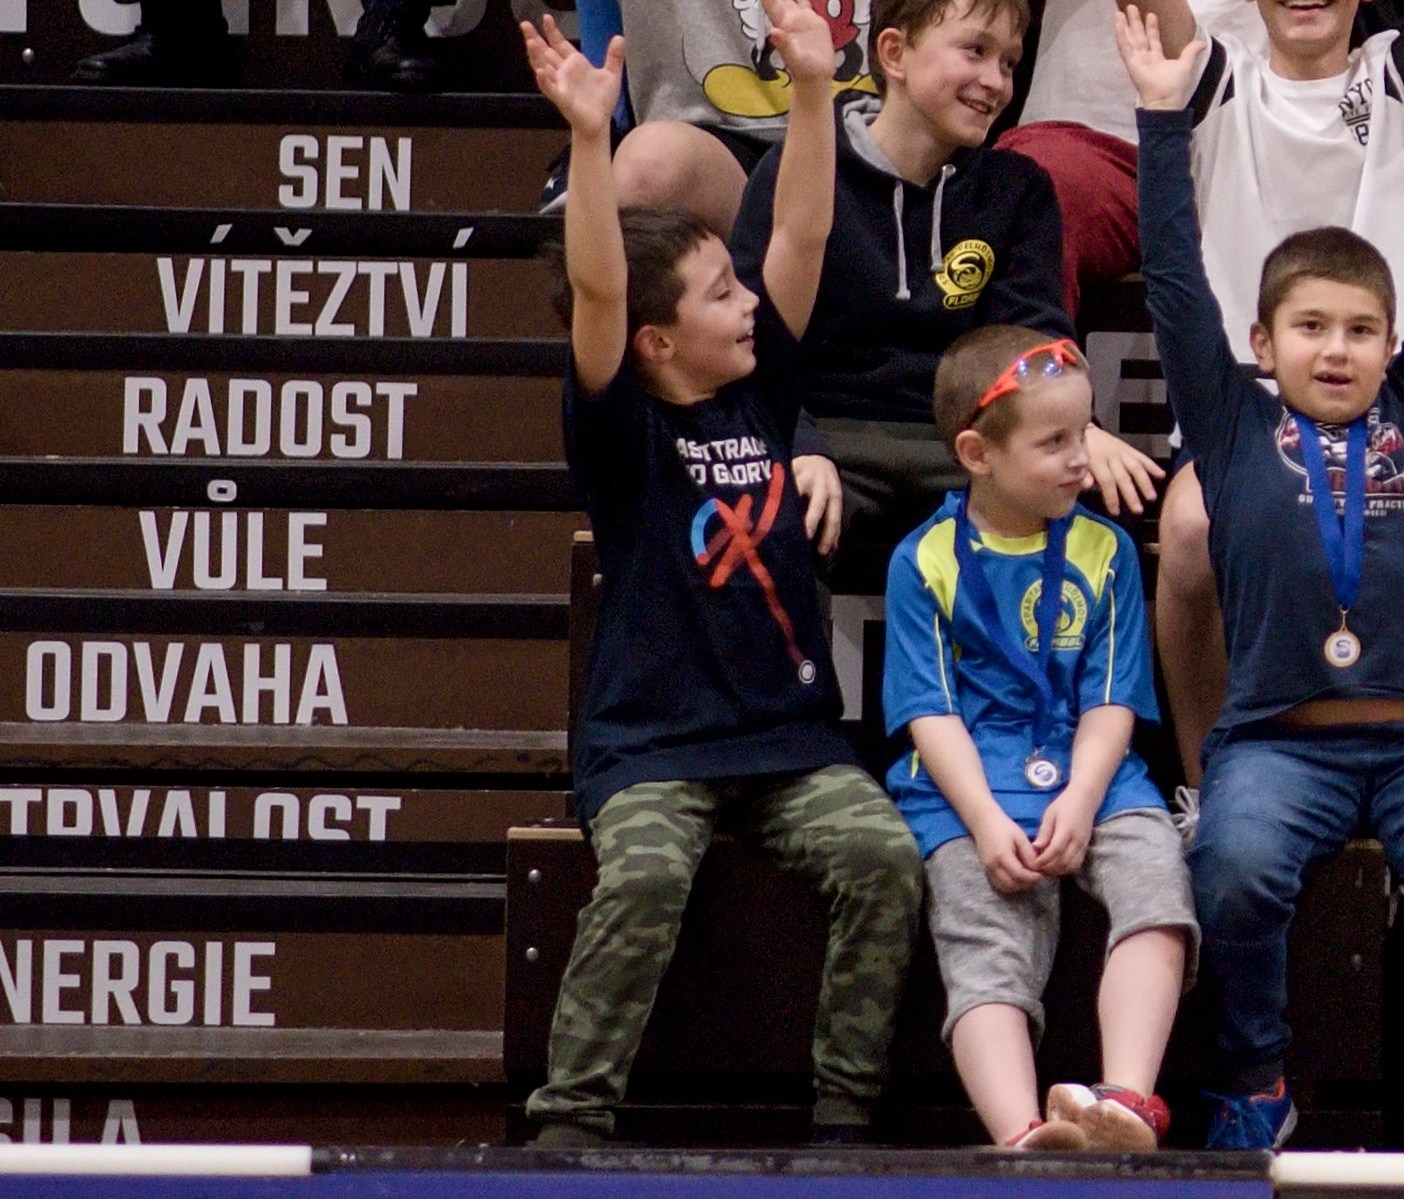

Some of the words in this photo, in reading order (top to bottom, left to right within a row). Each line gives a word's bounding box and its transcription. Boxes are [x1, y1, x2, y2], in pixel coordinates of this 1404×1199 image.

[278, 134, 413, 212] SEN
[157, 223, 473, 338] VÍTĚZTVÍ
[123, 375, 418, 460] RADOST
[676, 437, 712, 462] AST
[686, 462, 707, 485] O
[139, 478, 329, 592] VŮLE
[26, 640, 349, 726] ODVAHA
[0, 939, 276, 1027] NERGIE
